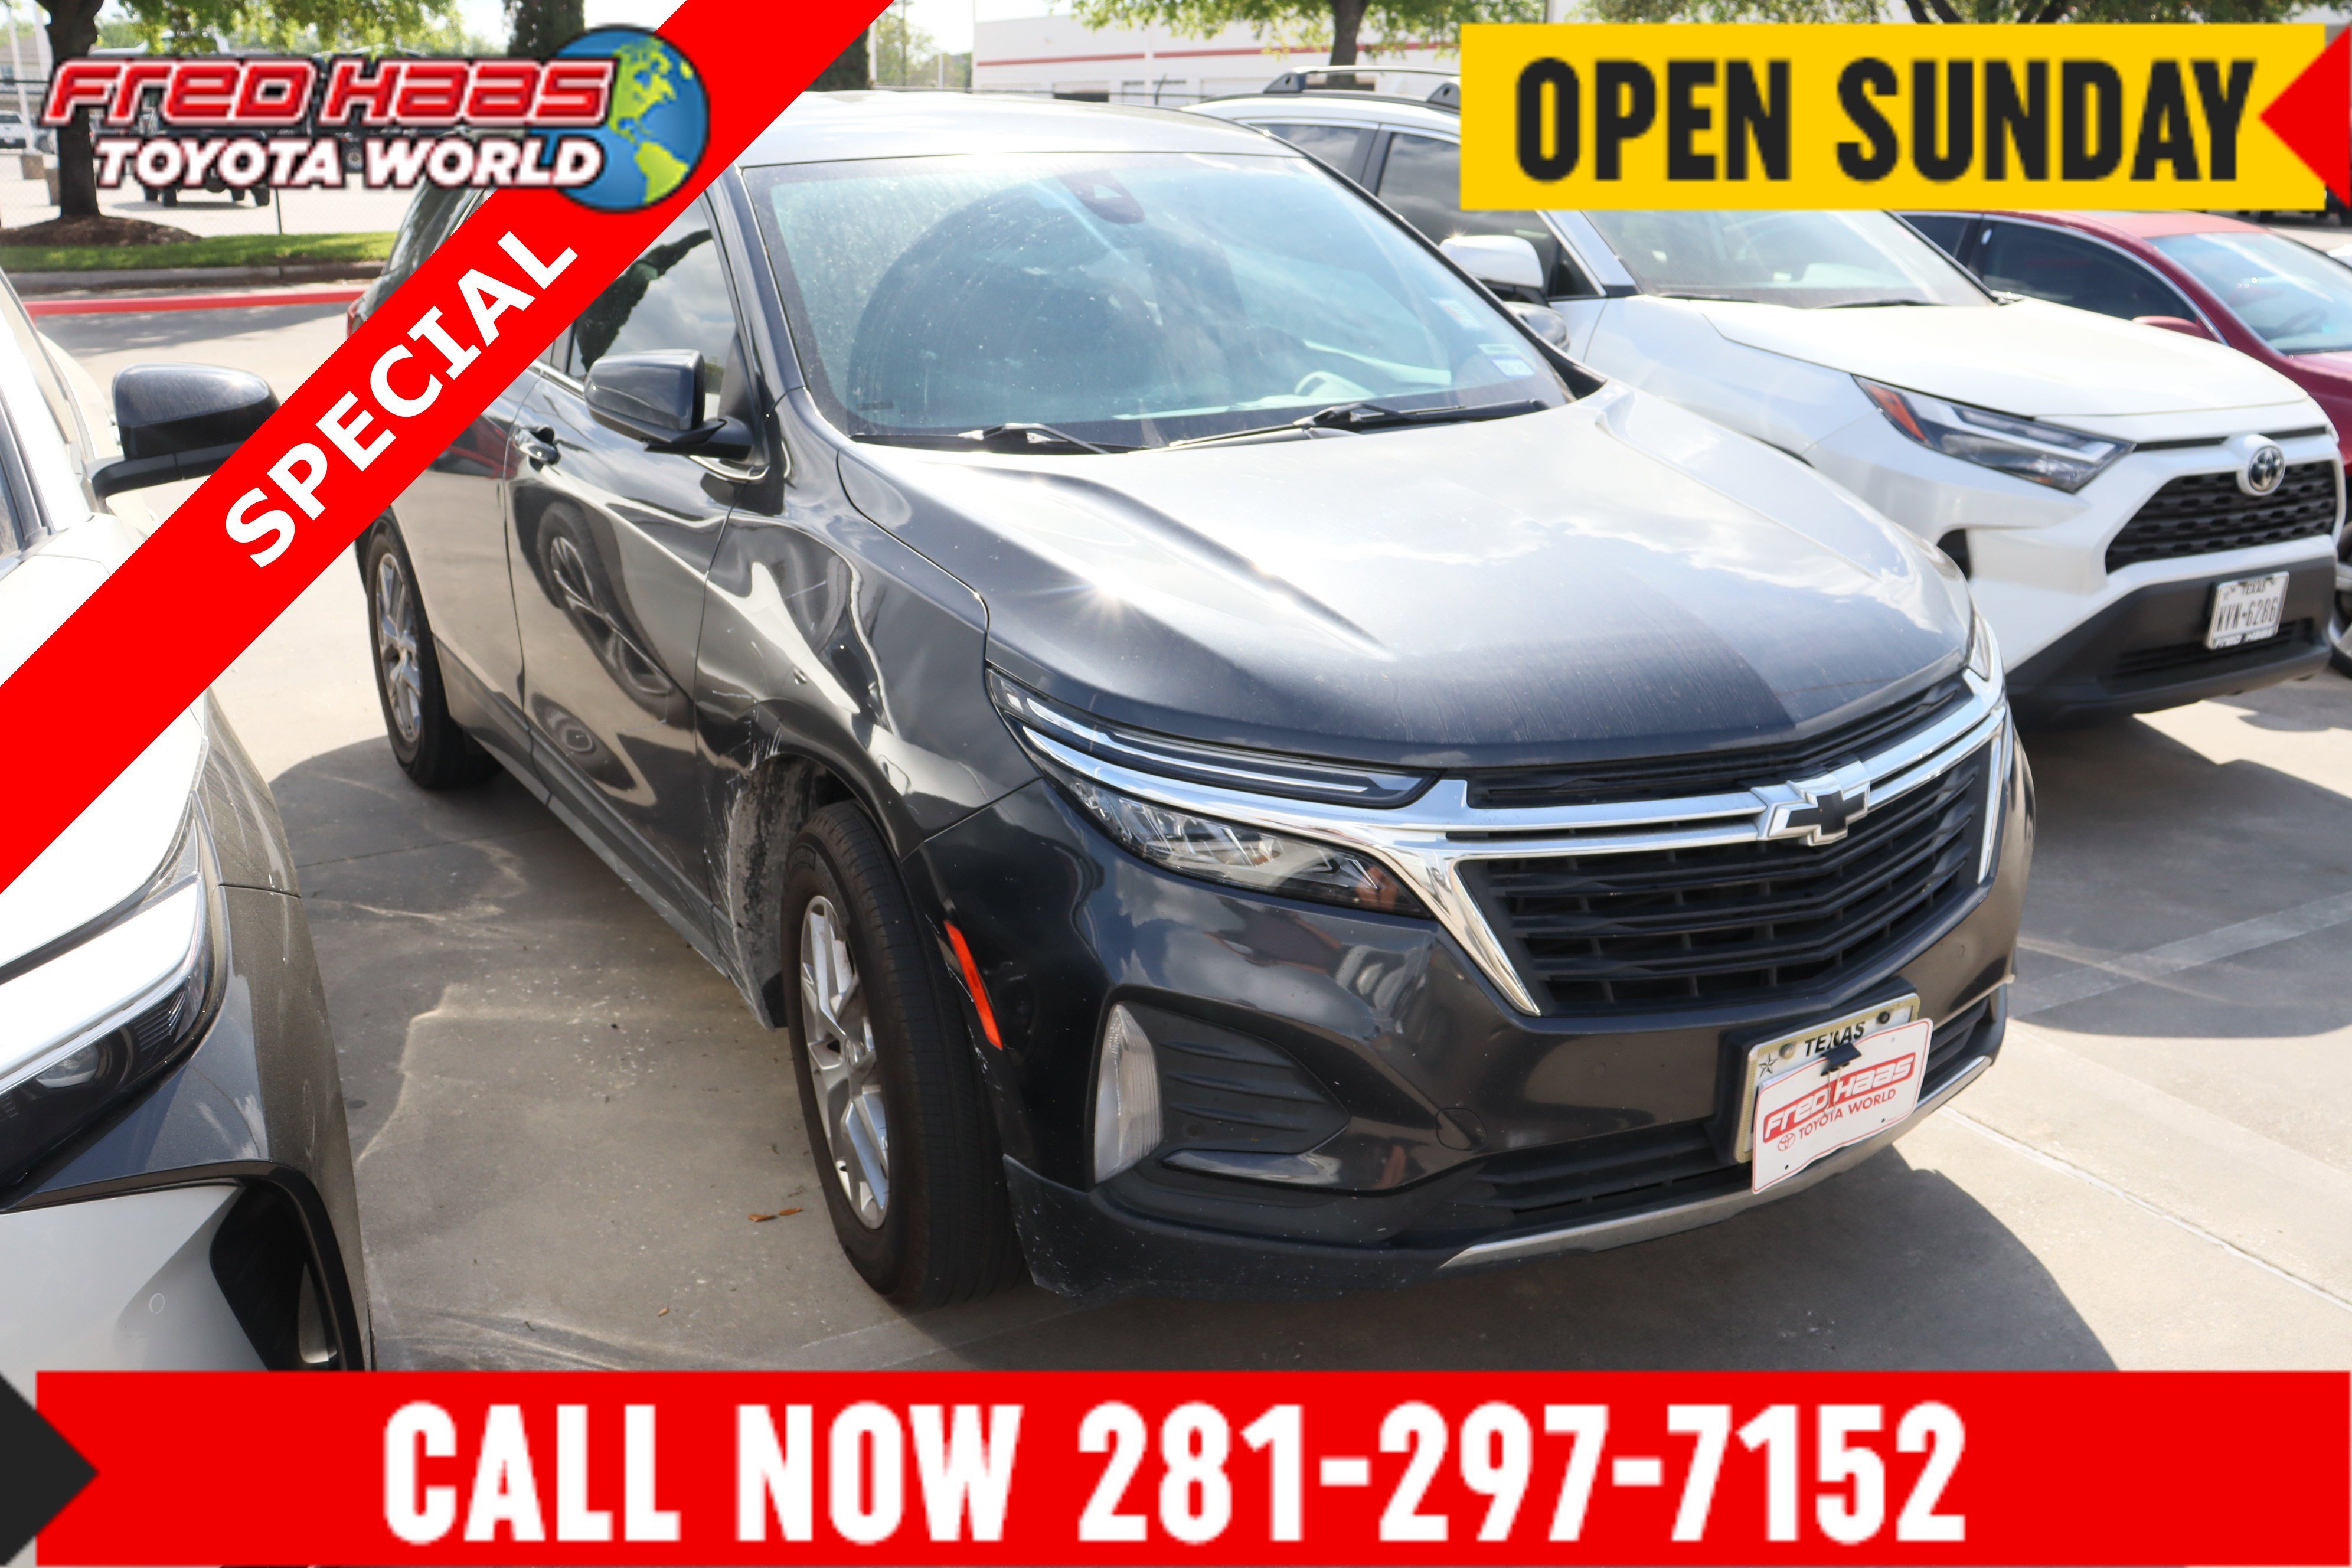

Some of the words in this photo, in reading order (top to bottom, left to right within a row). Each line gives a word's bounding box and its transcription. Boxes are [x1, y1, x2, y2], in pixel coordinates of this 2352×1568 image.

[1804, 1021, 1866, 1057] TEXAS
[1799, 1107, 1843, 1139] TOYOTA
[1848, 1088, 1896, 1114] WORLD
